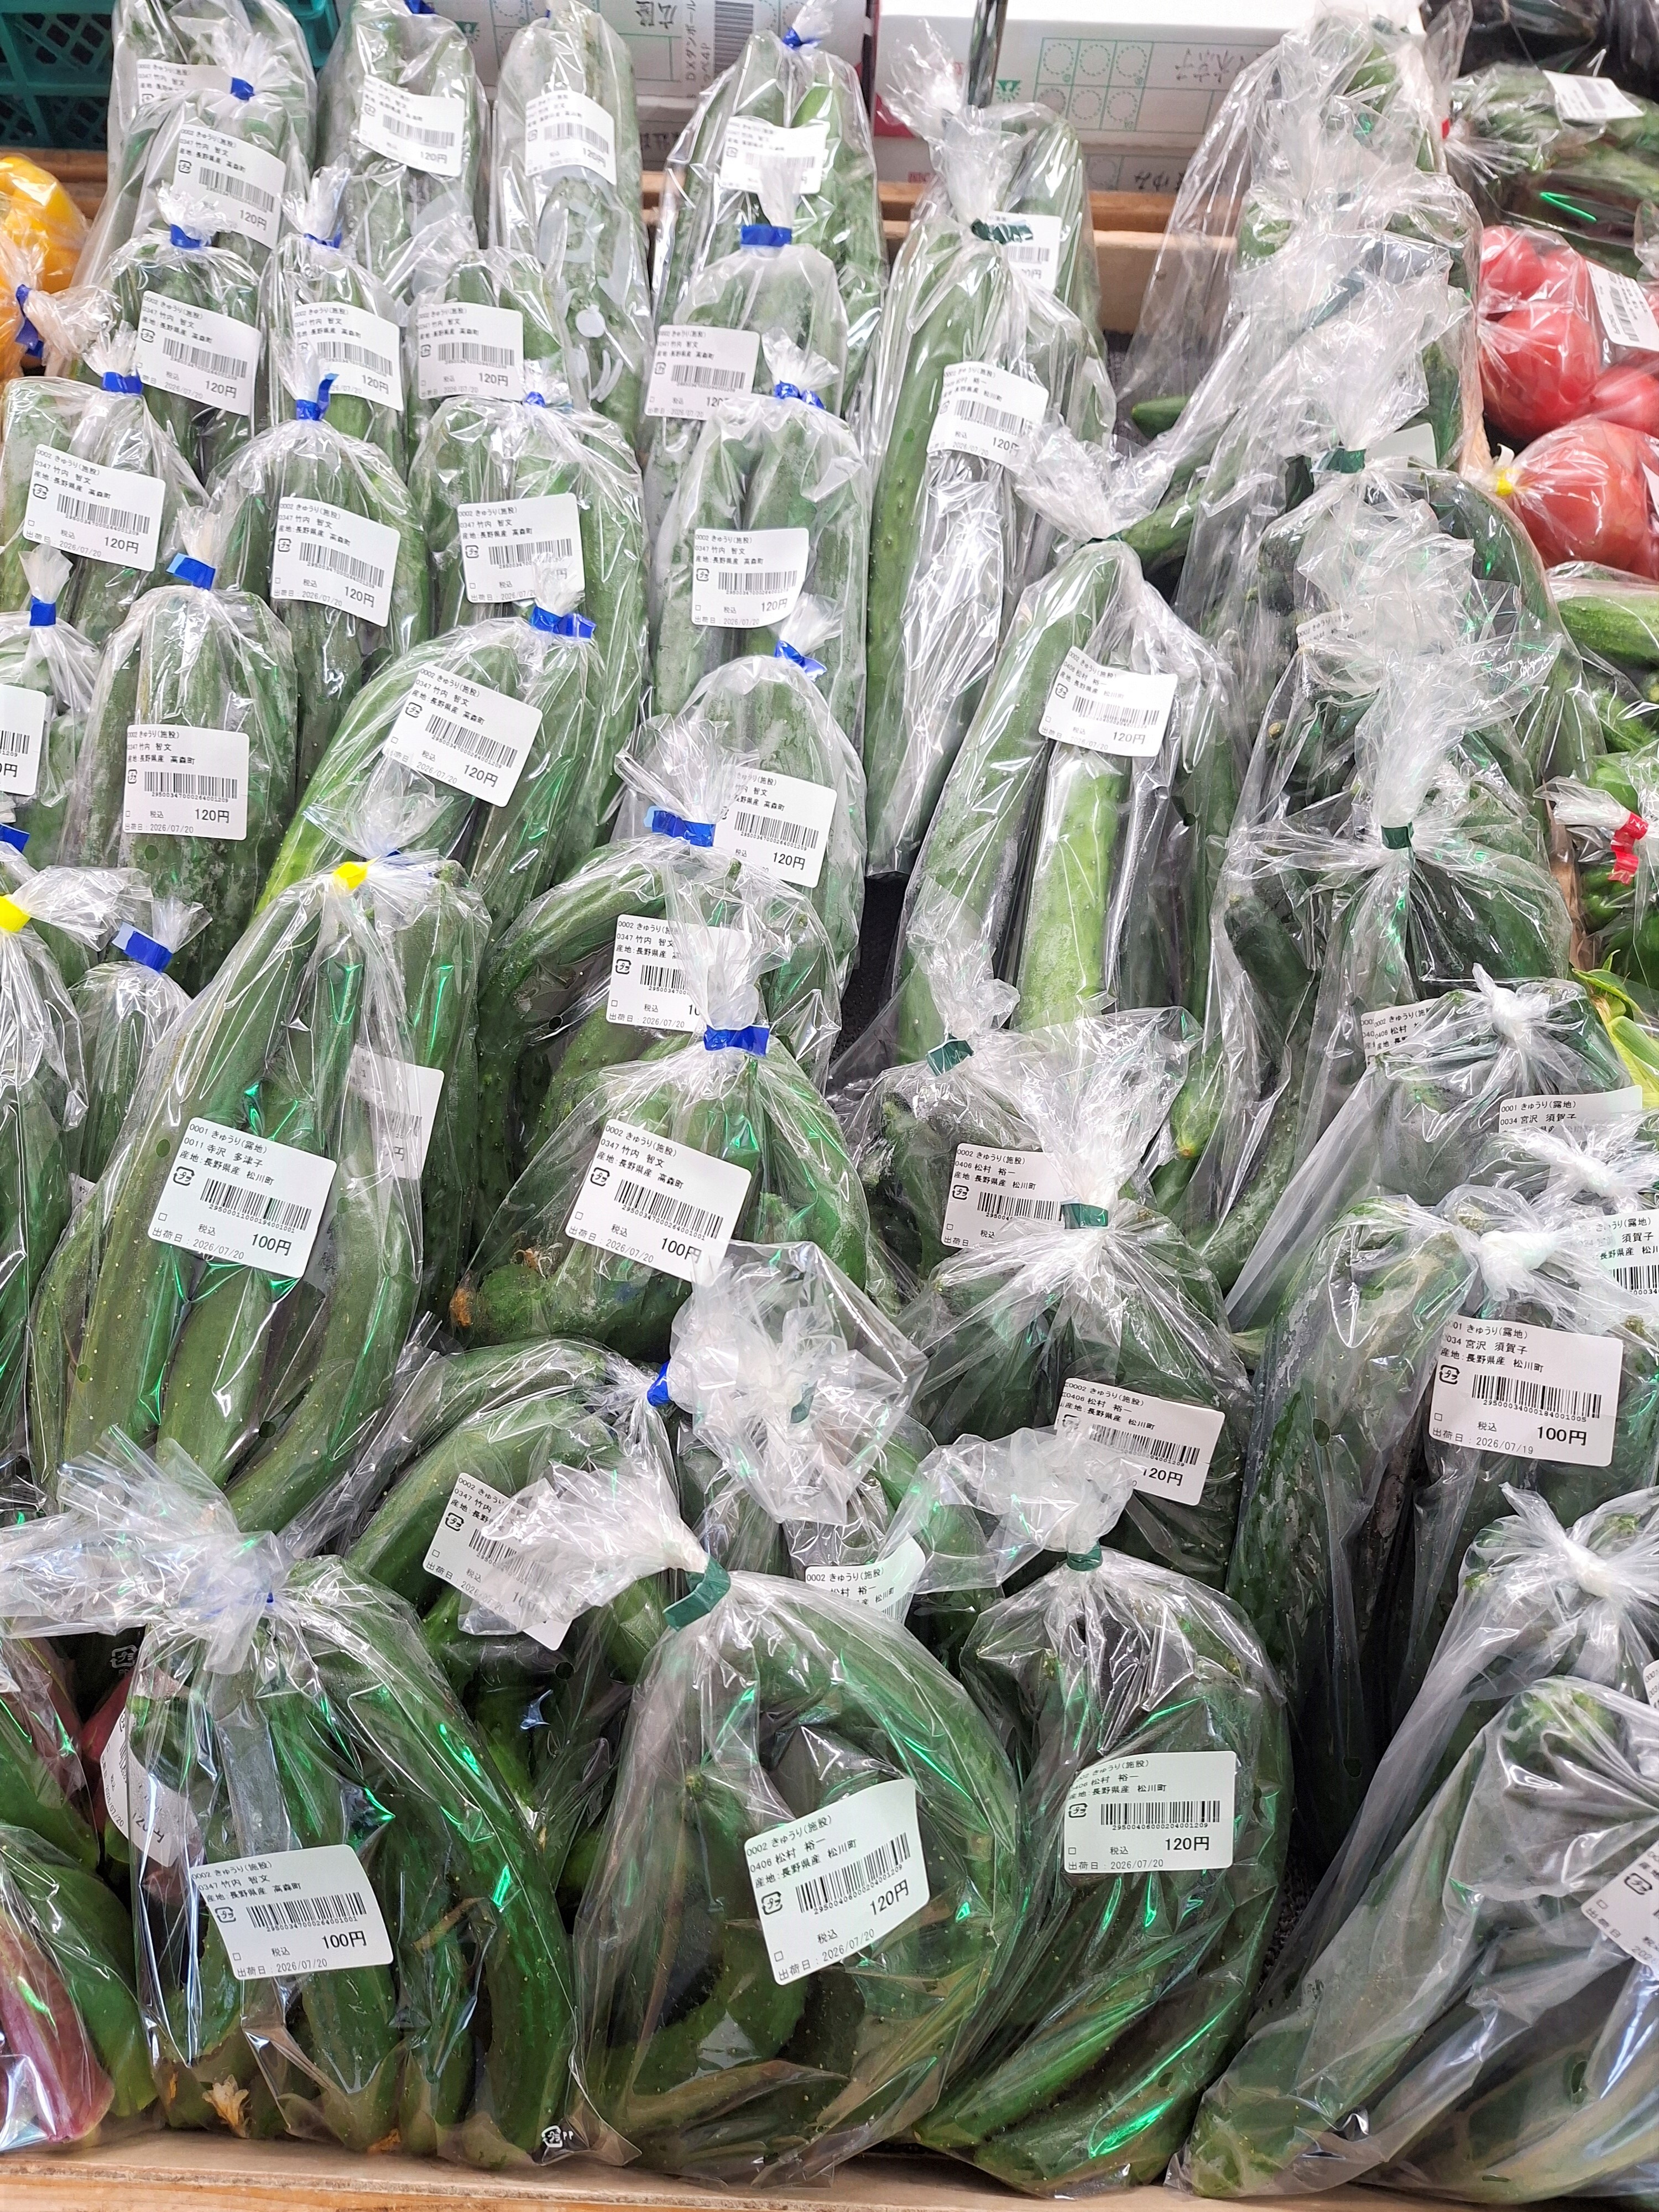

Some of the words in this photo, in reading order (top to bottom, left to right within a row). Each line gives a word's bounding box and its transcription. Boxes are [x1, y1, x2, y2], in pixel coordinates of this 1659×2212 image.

[421, 151, 447, 164] 120円
[240, 210, 267, 230] 120円
[362, 375, 389, 394] 120円
[479, 373, 508, 386] 120円
[206, 380, 237, 398] 120円
[36, 450, 51, 459] 0002
[35, 461, 51, 469] 0347
[53, 466, 69, 477] 竹内
[75, 473, 91, 484] 智文
[104, 536, 139, 554] 120円
[345, 586, 374, 608] 120円
[761, 598, 787, 612] 120円
[1069, 651, 1080, 662] 0002
[420, 668, 435, 679] 0002
[1076, 669, 1088, 681] 松村
[416, 679, 431, 690] 0347
[433, 686, 448, 698] 竹内
[453, 695, 469, 707] 智文
[462, 711, 486, 725] 高森町
[1113, 732, 1145, 744] 120円
[155, 743, 171, 751] 智文
[170, 756, 195, 765] 高森町
[421, 750, 436, 762] 税込
[463, 765, 499, 787] 120円
[754, 787, 768, 796] 智文
[764, 801, 785, 811] 高森町
[195, 809, 229, 823] 120円
[773, 852, 805, 870] 120円
[635, 935, 652, 944] 竹内
[644, 1004, 658, 1012] 税込
[1374, 1018, 1386, 1027] 0002
[1390, 1025, 1407, 1035] 松村
[1501, 1104, 1517, 1113] 0001
[1500, 1117, 1517, 1125] 0034
[1520, 1114, 1538, 1124] 宮沢
[1546, 1113, 1577, 1123] 須賀子
[189, 1124, 208, 1135] 0001
[606, 1125, 624, 1137] 0002
[184, 1137, 204, 1149] 0011
[207, 1144, 226, 1157] 寺沢
[233, 1152, 263, 1167] 多津子
[601, 1139, 619, 1150] 0347
[622, 1145, 640, 1159] 竹内
[646, 1154, 665, 1168] 智文
[974, 1164, 992, 1173] 松村
[998, 1167, 1015, 1176] 裕一
[247, 1171, 274, 1185] 松川町
[658, 1173, 684, 1189] 高森町
[1013, 1182, 1037, 1190] 松川町
[198, 1224, 216, 1237] 税込
[611, 1224, 628, 1237] 税込
[1622, 1232, 1653, 1243] 須賀子
[193, 1239, 244, 1260] 2026/07/20
[252, 1233, 291, 1256] 100円
[606, 1239, 654, 1262] 2026/07/20
[661, 1238, 701, 1264] 100円
[1465, 1339, 1486, 1350] 宮沢
[1495, 1342, 1527, 1354] 須賀子
[1513, 1358, 1544, 1373] 松川町
[1069, 1383, 1087, 1392] 0002
[1067, 1393, 1084, 1402] 0406
[1087, 1398, 1106, 1407] 松村
[1113, 1404, 1132, 1413] 裕一
[1128, 1418, 1155, 1430] 松川町
[1478, 1421, 1497, 1432] 税込
[1537, 1426, 1587, 1446] 100円
[1476, 1437, 1533, 1455] 2026/07/19
[458, 1477, 476, 1491] 0002
[1143, 1468, 1183, 1486] 120円
[455, 1488, 472, 1501] 0347
[474, 1499, 492, 1513] 竹内
[466, 1568, 481, 1582] 税込
[858, 1586, 876, 1594] 裕一
[875, 1587, 895, 1603] 松川町
[1092, 1776, 1110, 1786] 松村
[1118, 1773, 1139, 1782] 裕一
[1138, 1784, 1166, 1792] 松川町
[747, 1843, 768, 1856] 0002
[828, 1839, 857, 1858] 松川町
[1110, 1846, 1129, 1855] 税込
[1165, 1836, 1209, 1851] 120円
[750, 1858, 772, 1872] 0406
[775, 1848, 797, 1864] 松村
[804, 1837, 826, 1852] 裕一
[1111, 1859, 1164, 1870] 2026/07/20
[199, 1882, 218, 1891] 0347
[221, 1879, 242, 1888] 竹内
[248, 1875, 270, 1884] 智文
[273, 1882, 302, 1893] 高森町
[869, 1879, 910, 1916] 120円
[322, 1931, 367, 1949] 100円
[817, 1929, 838, 1944] 税込
[270, 1947, 290, 1957] 税込
[822, 1928, 874, 1962] 2026/07/20
[276, 1958, 327, 1973] 2026/07/20
